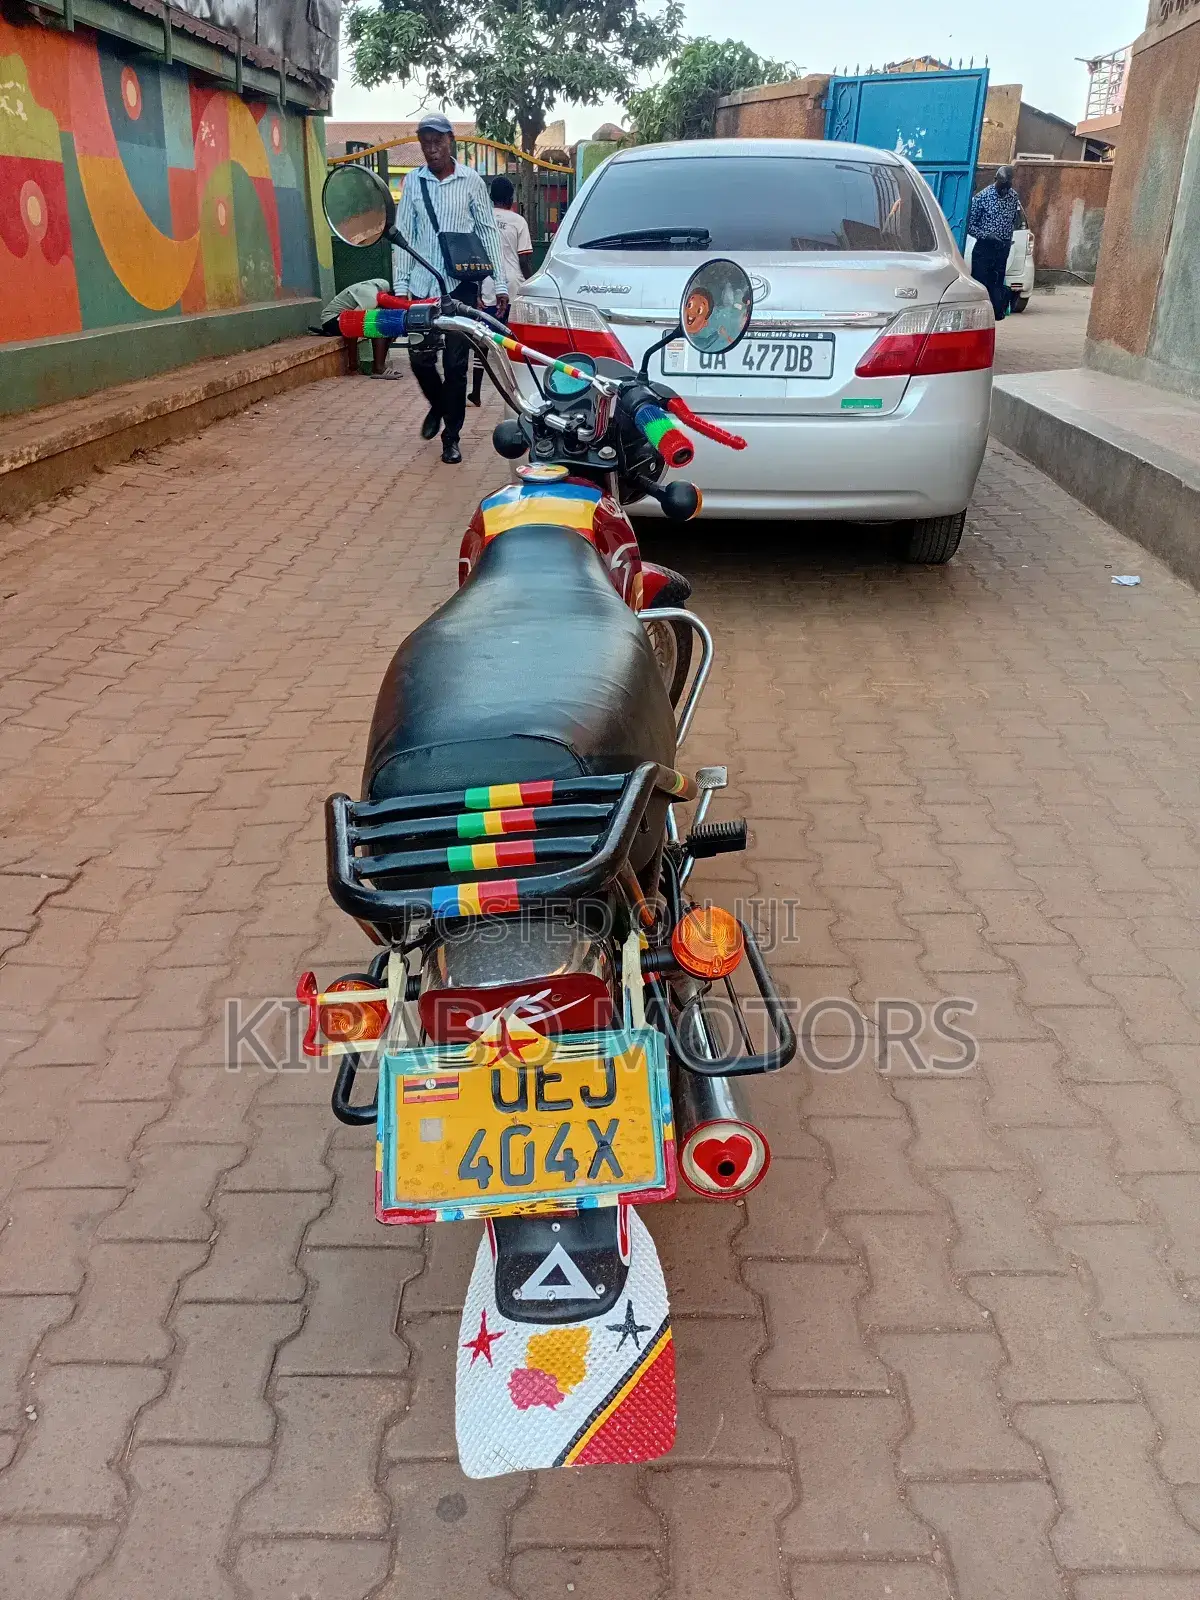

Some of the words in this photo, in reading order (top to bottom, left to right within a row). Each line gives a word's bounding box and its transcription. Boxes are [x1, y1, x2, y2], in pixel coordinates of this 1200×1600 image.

[788, 331, 809, 339] Space
[742, 342, 813, 372] 477DB
[490, 1057, 618, 1113] UEJ
[457, 1118, 624, 1190] 404X
